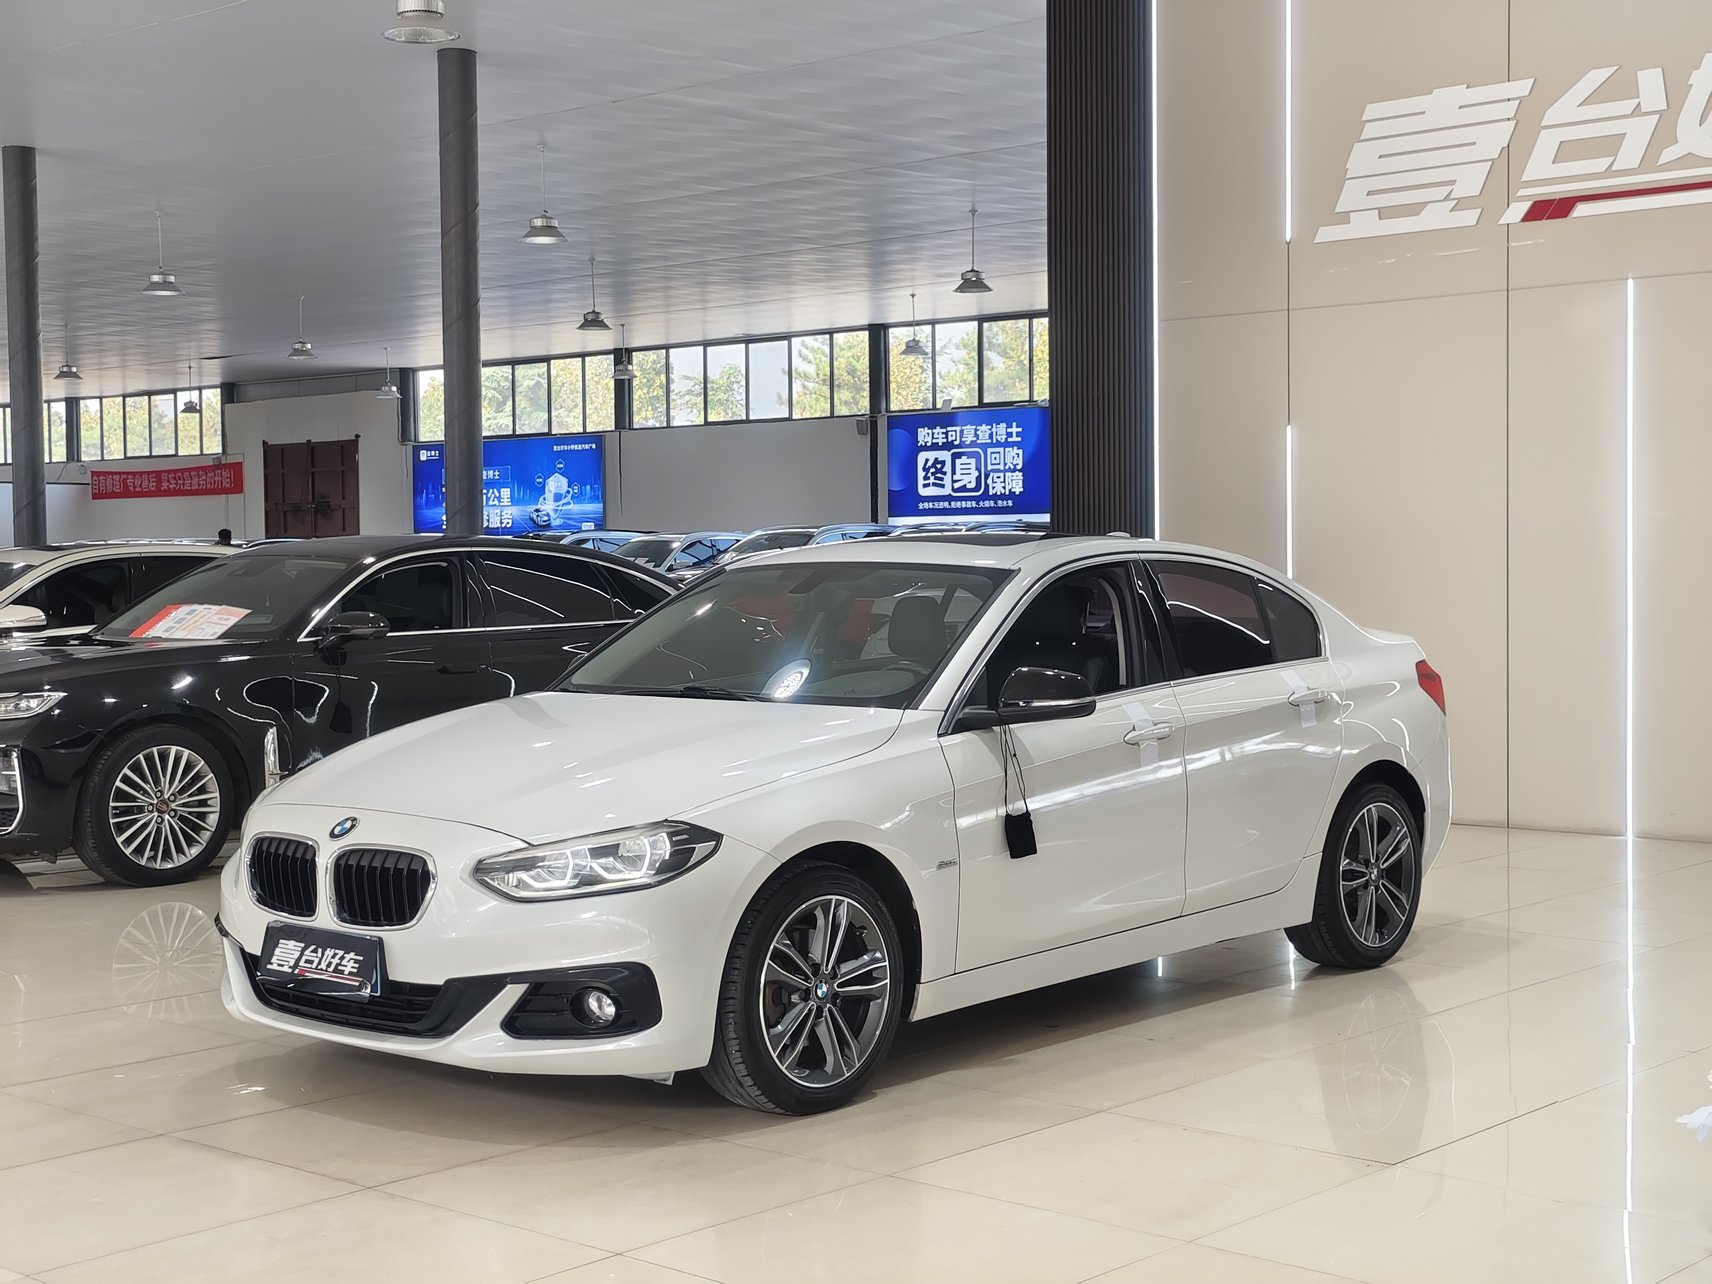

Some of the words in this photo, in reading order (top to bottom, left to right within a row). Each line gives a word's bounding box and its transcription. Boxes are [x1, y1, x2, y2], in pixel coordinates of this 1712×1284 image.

[917, 422, 1023, 447] 购车可享查博士
[986, 446, 1023, 470] 回购
[920, 455, 980, 490] 终身
[987, 472, 1024, 496] 保障
[266, 939, 364, 975] 壹台好车
